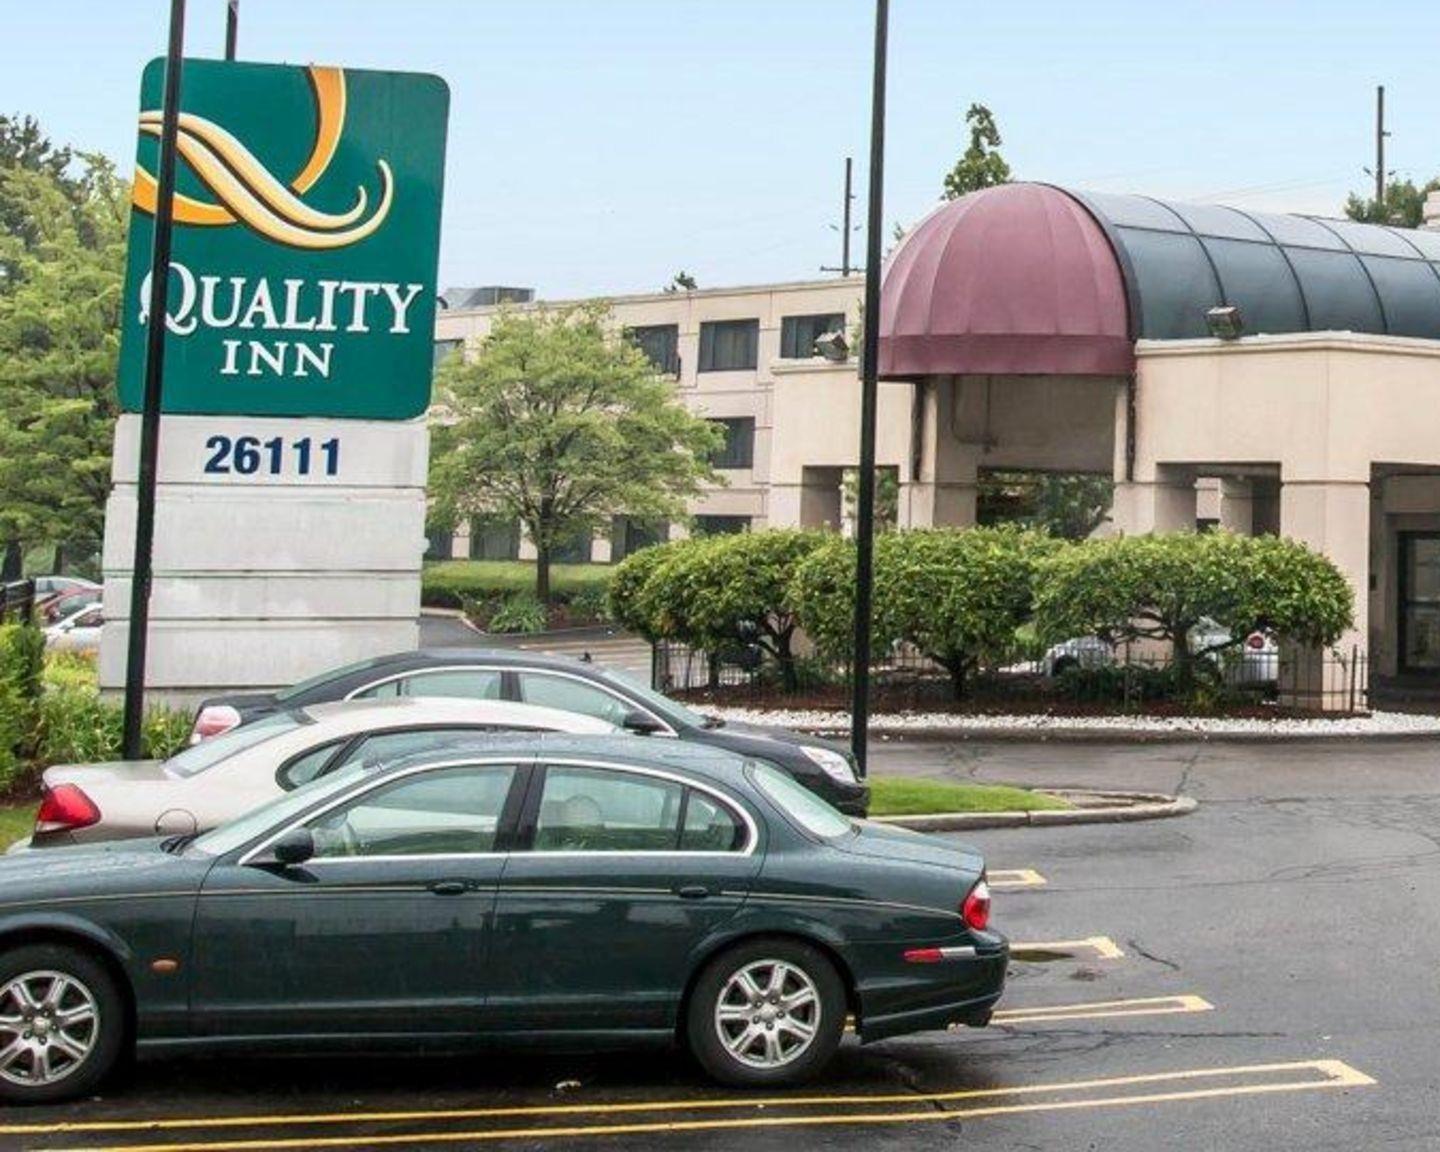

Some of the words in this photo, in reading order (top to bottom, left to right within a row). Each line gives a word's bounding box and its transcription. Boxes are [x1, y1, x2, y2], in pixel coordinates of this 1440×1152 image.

[139, 261, 423, 336] QUALITY
[220, 339, 335, 377] INN
[204, 435, 340, 476] 26111
